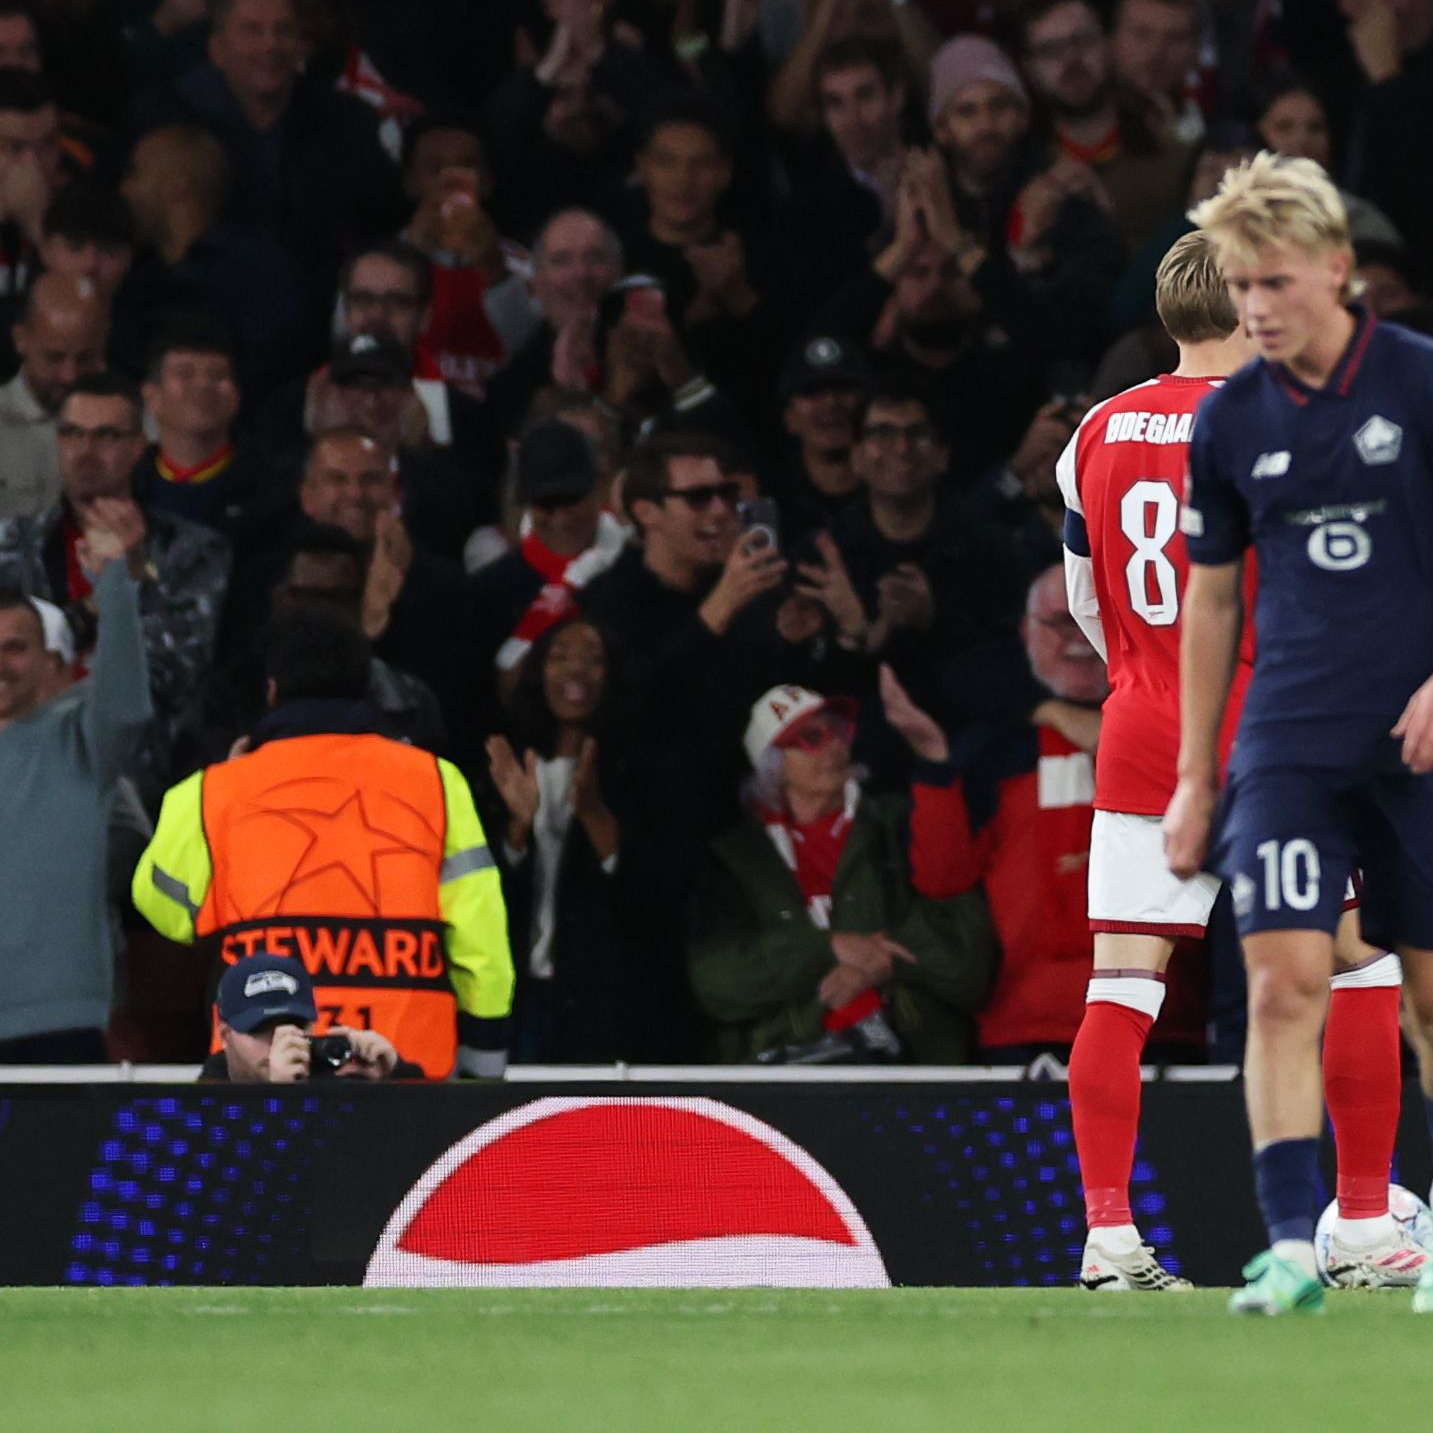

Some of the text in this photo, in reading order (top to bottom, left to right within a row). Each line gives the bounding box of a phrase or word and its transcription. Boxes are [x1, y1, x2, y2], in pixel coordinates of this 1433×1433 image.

[1120, 480, 1179, 626] 8
[1256, 838, 1321, 911] 10
[221, 926, 444, 978] STEWARD
